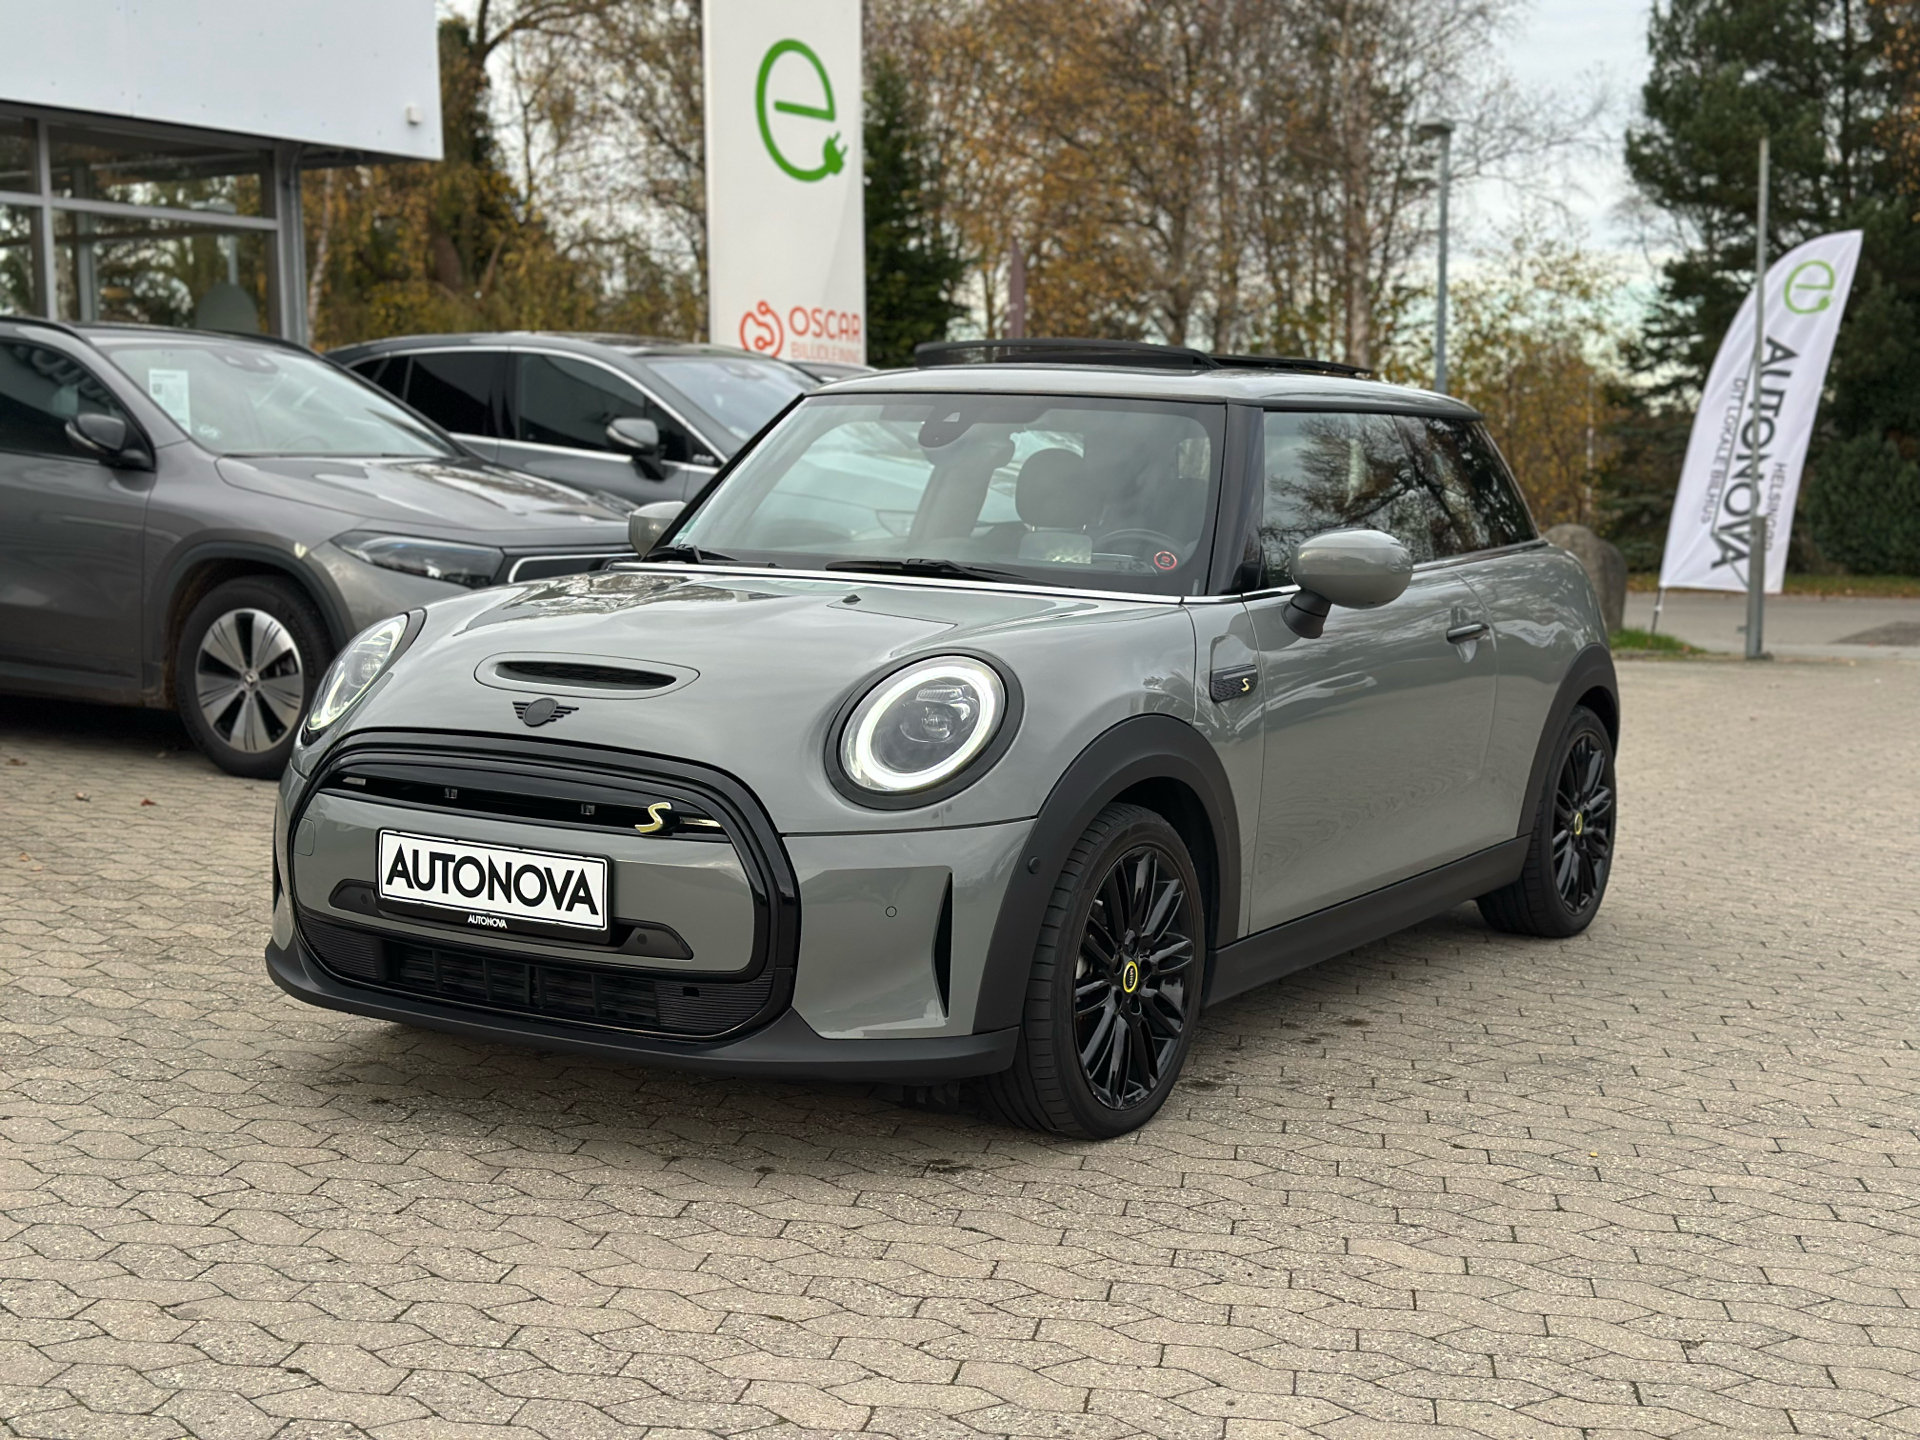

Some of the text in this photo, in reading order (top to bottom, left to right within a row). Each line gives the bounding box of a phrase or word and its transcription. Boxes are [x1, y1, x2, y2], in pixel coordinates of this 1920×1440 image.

[789, 305, 861, 344] OSCAR
[1710, 336, 1800, 570] AUTONOVA
[1713, 404, 1742, 465] LOKALE
[1700, 469, 1725, 524] BILHUS
[635, 801, 672, 834] S
[385, 843, 599, 916] AUTONOVA
[467, 914, 508, 930] AUTONOVA
